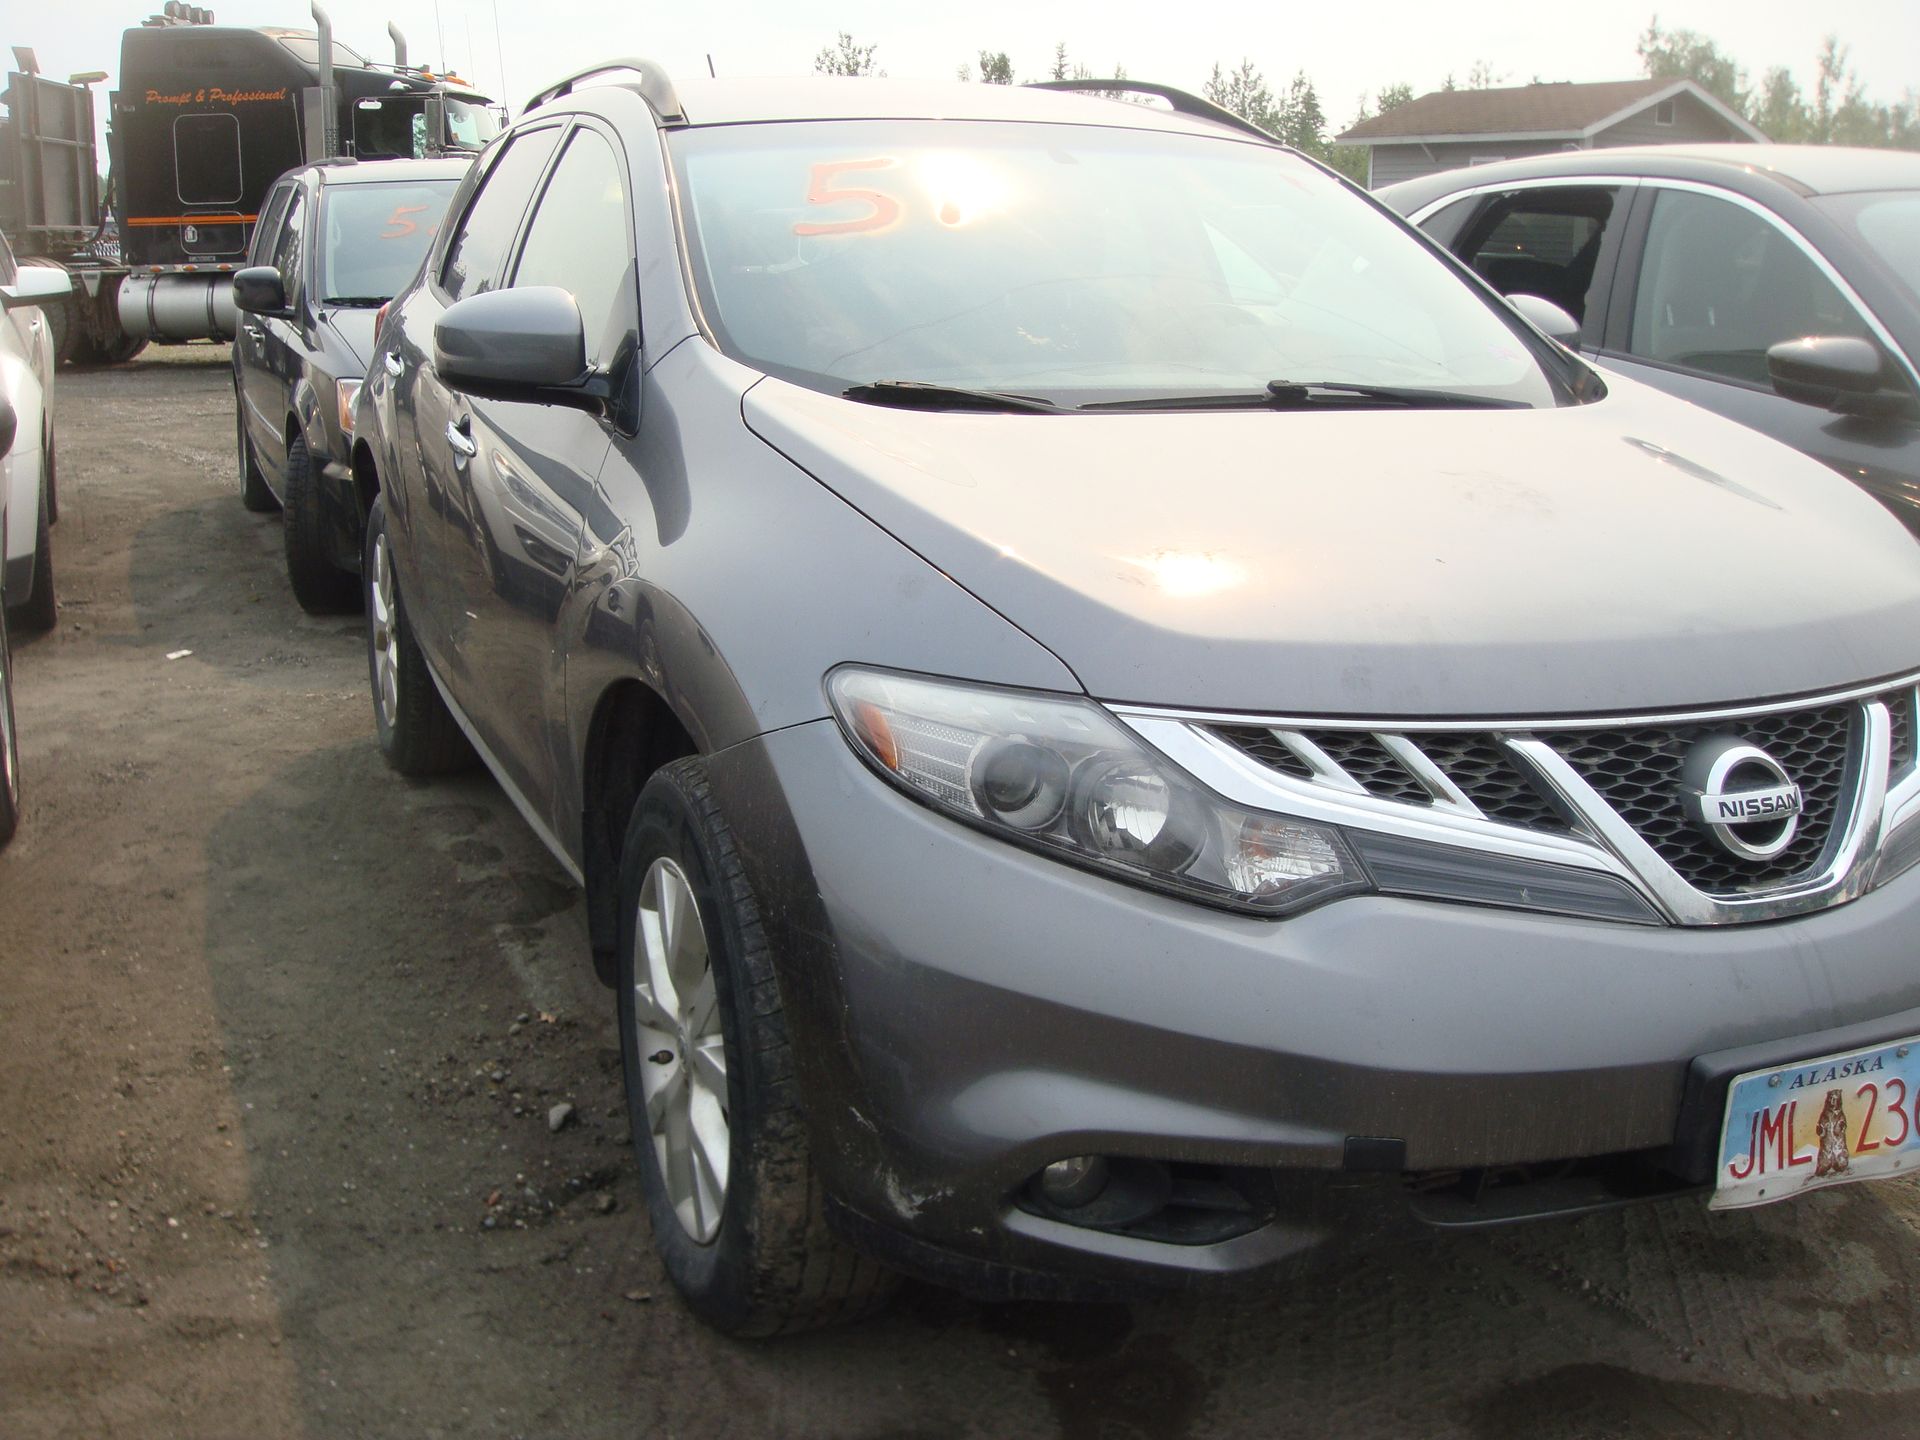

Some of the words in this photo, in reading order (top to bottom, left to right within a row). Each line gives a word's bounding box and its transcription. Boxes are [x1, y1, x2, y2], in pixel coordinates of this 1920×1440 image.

[145, 88, 192, 106] Prompt
[195, 89, 205, 103] &
[208, 87, 287, 106] Professional
[1718, 788, 1799, 818] NISSAN
[1789, 1056, 1884, 1090] ALASKA
[1729, 1100, 1813, 1180] JML
[1856, 1078, 1920, 1153] 23
